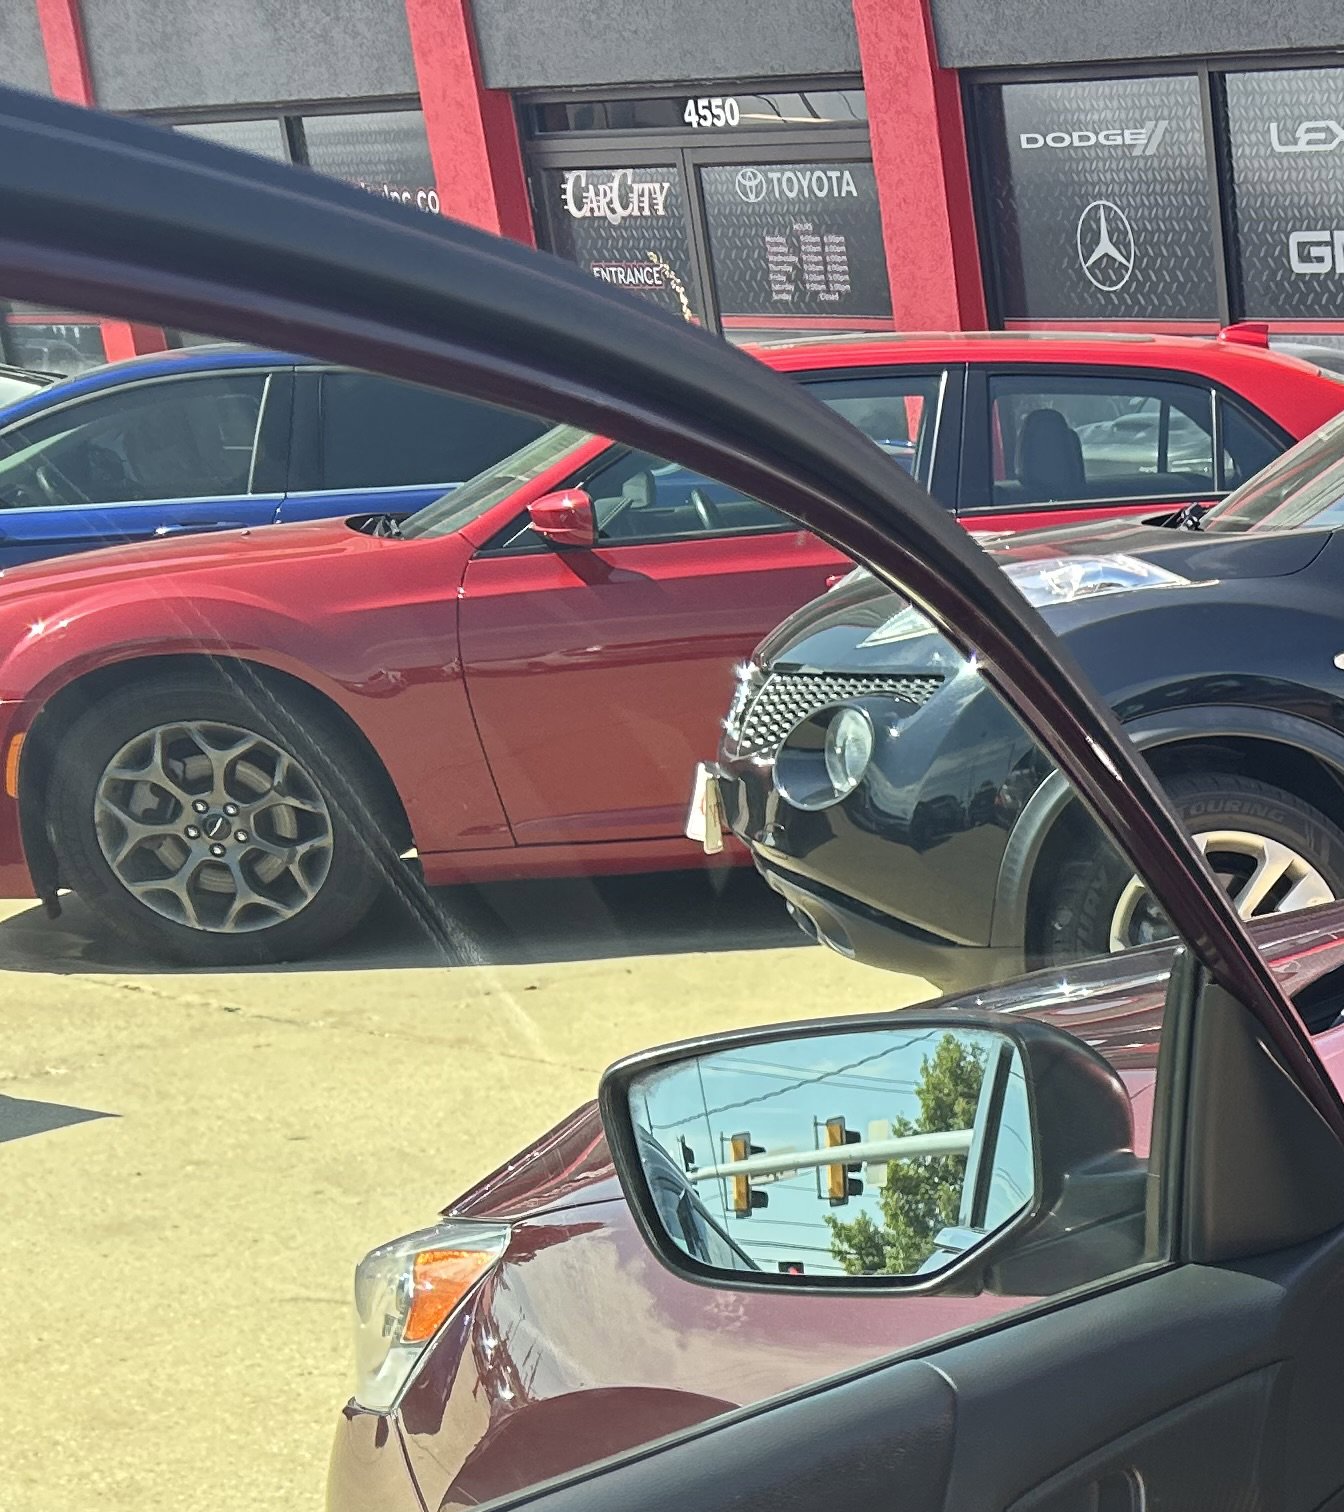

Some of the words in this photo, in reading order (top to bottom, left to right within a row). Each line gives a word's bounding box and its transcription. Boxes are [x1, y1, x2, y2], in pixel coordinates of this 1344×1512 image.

[684, 97, 740, 128] 4550
[1019, 128, 1147, 150] DODGE
[767, 170, 858, 199] TOYOTA
[593, 266, 662, 286] ENTRANCE
